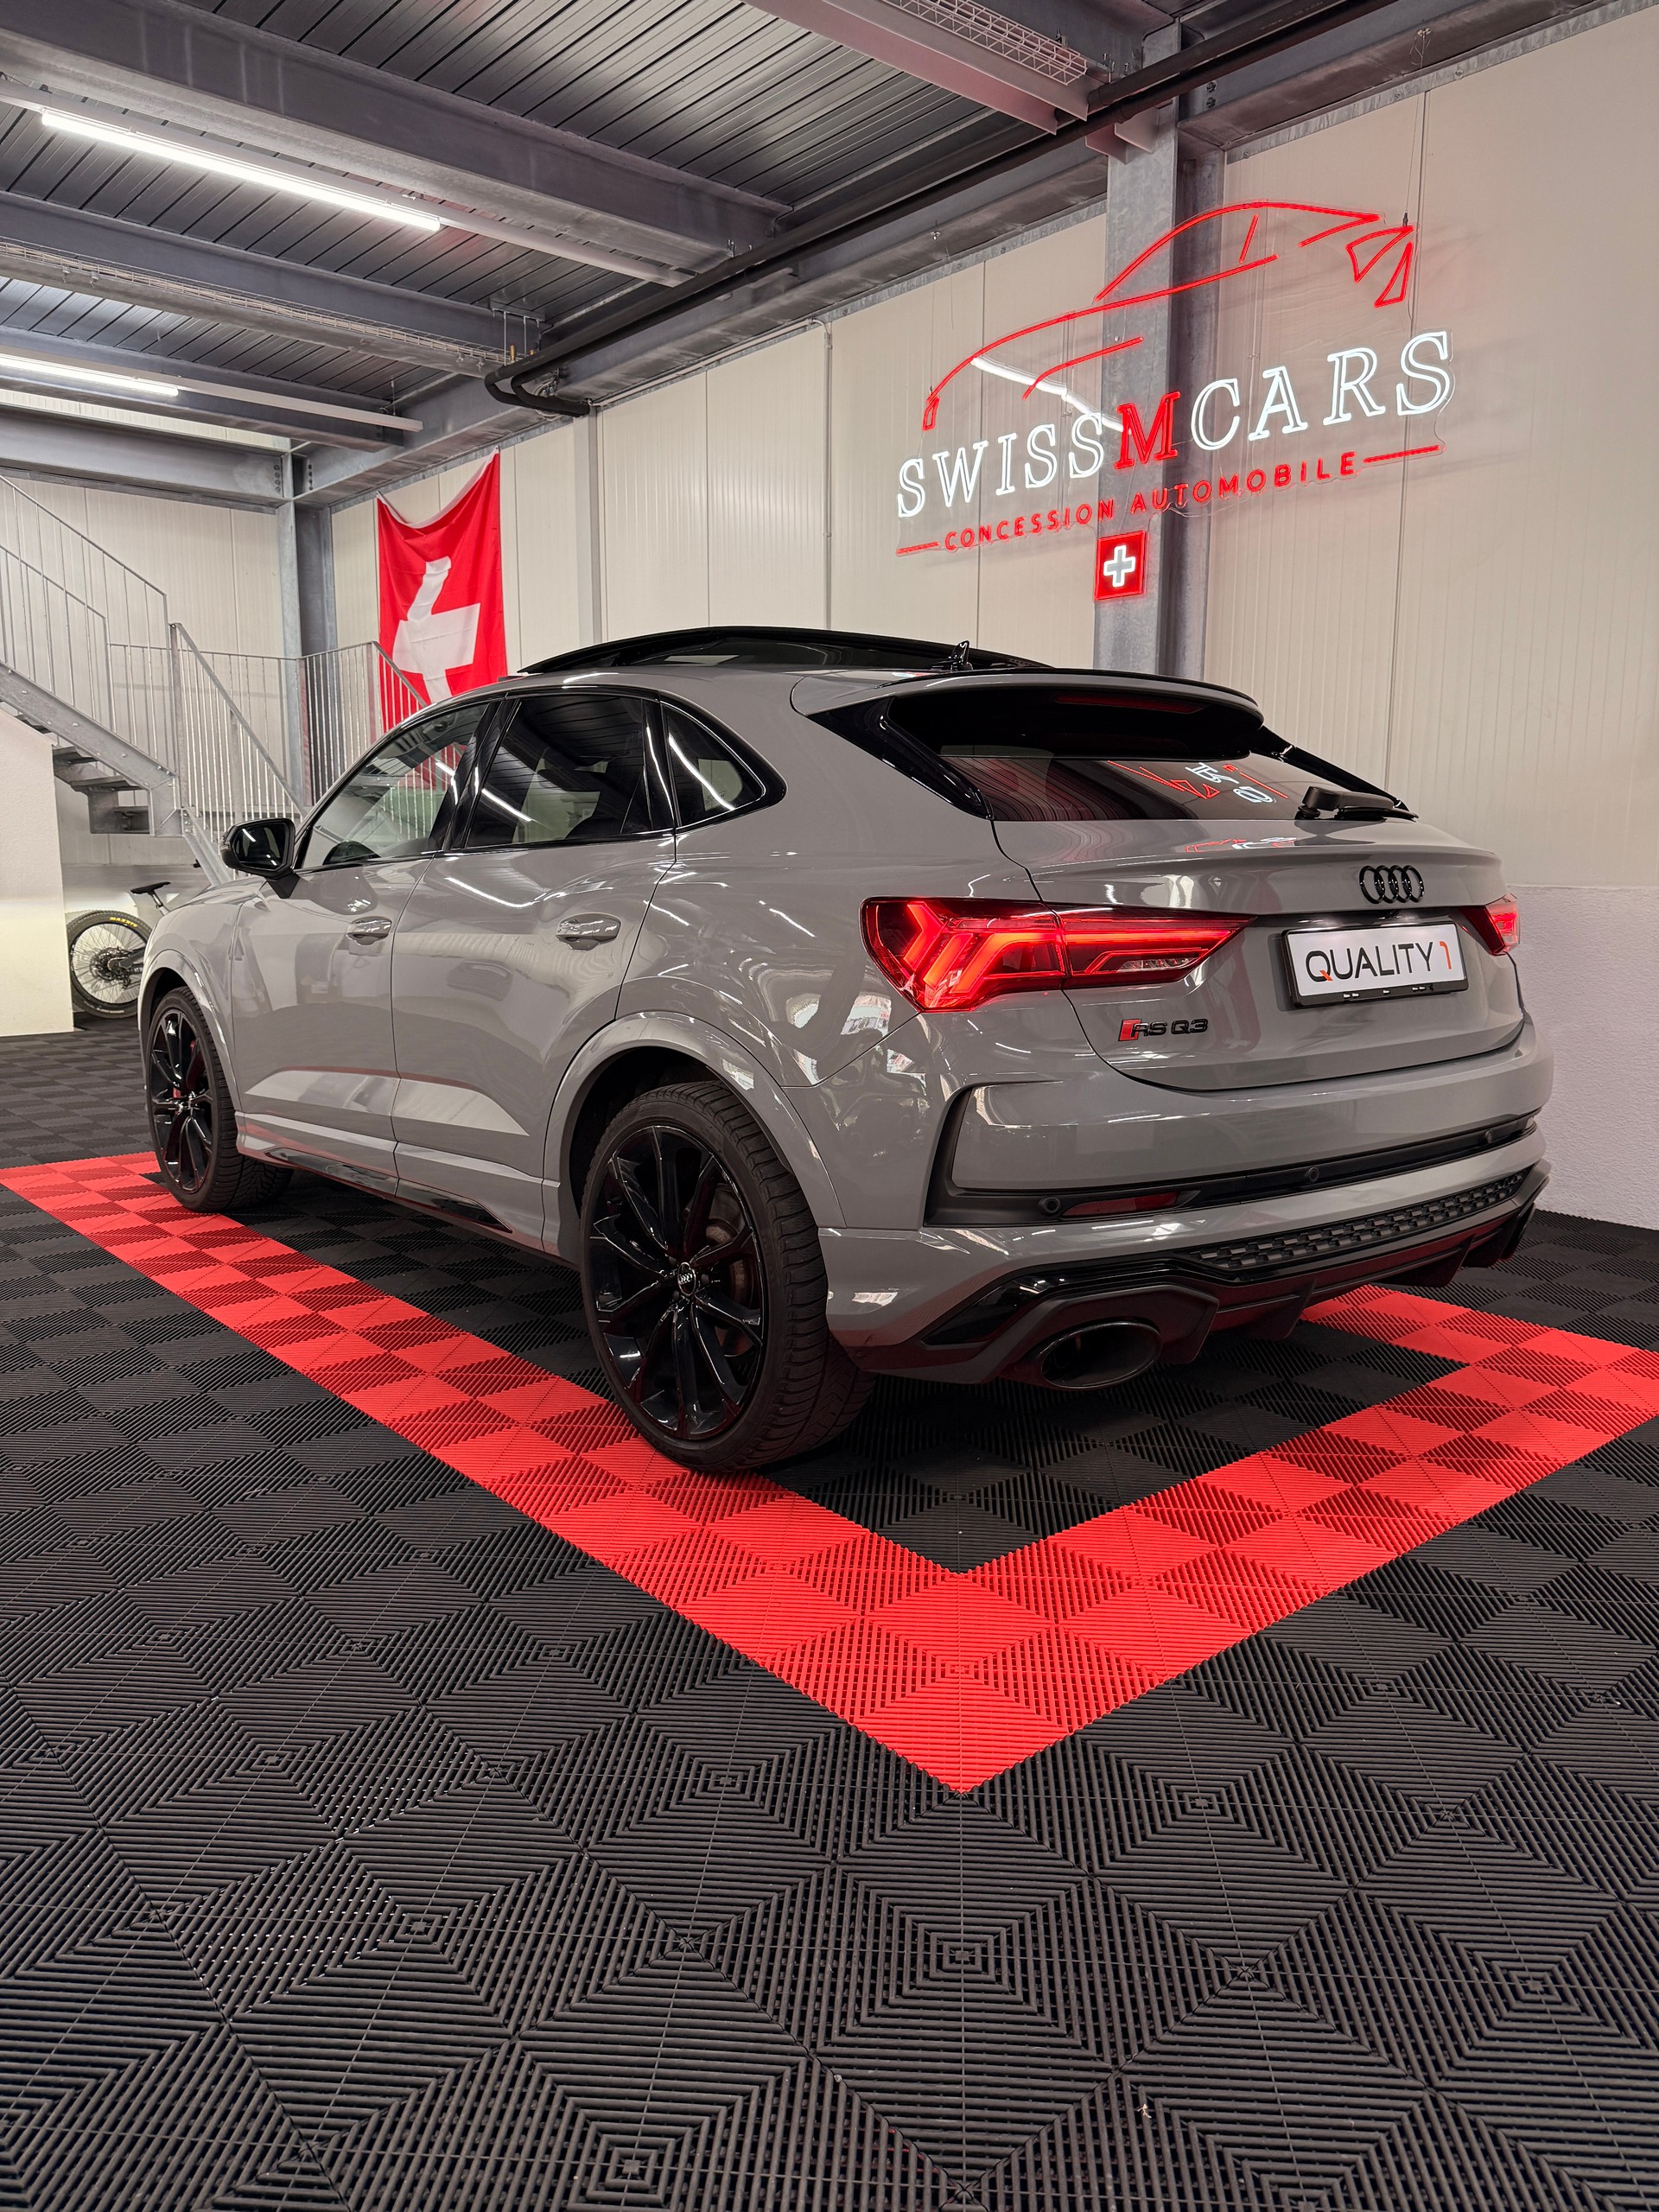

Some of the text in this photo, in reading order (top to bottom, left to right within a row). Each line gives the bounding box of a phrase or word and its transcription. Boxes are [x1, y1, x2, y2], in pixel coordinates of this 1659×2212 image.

[944, 451, 1358, 551] CONCESSION AUTOMOBILE
[1129, 1019, 1209, 1038] RS Q3
